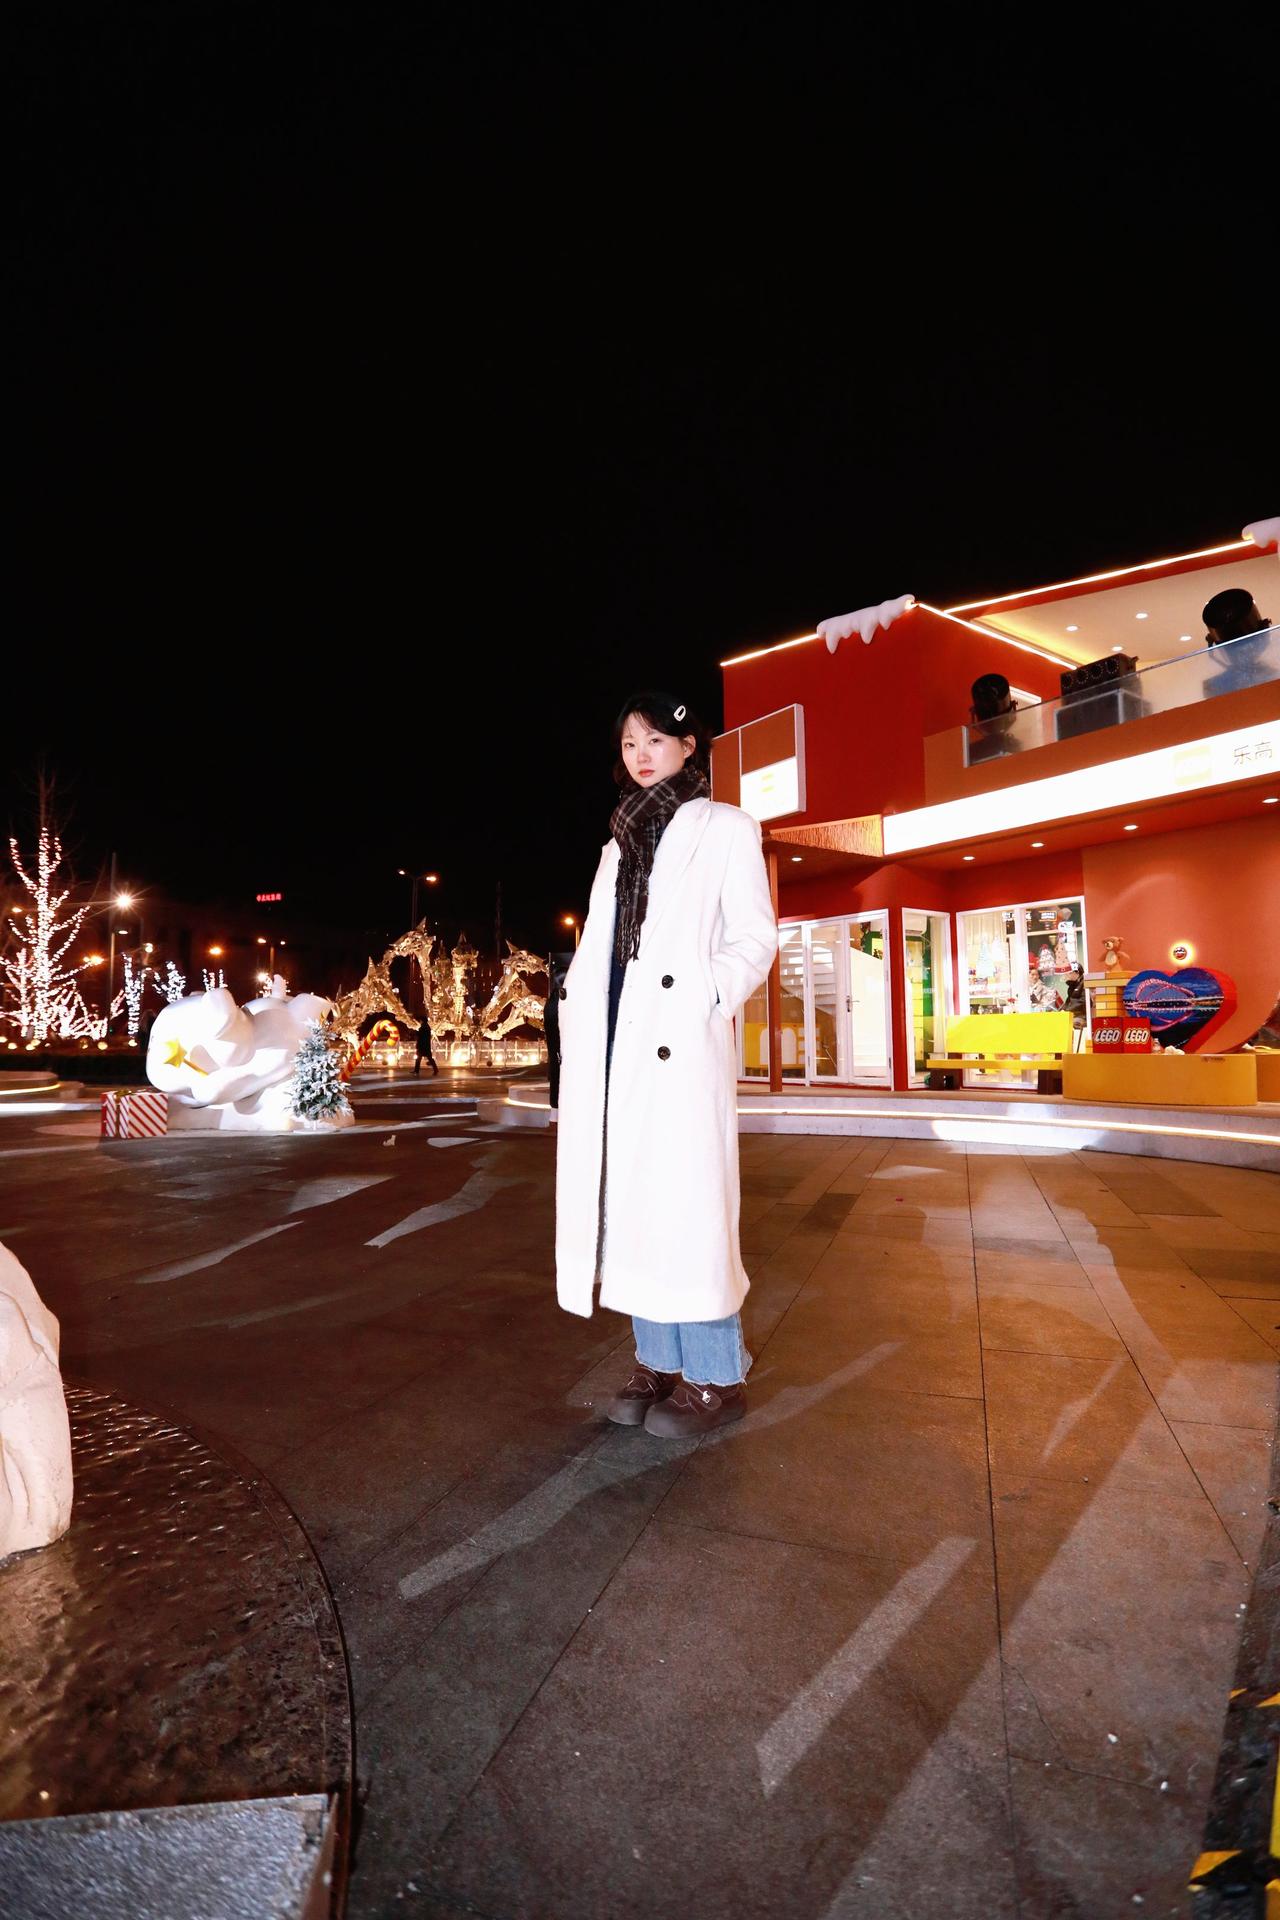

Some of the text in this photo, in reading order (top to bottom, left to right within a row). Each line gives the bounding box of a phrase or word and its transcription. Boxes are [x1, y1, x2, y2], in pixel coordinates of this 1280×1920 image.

[1233, 741, 1273, 765] 乐高
[1094, 1029, 1121, 1043] LEGO
[1123, 1029, 1150, 1043] LEGO
